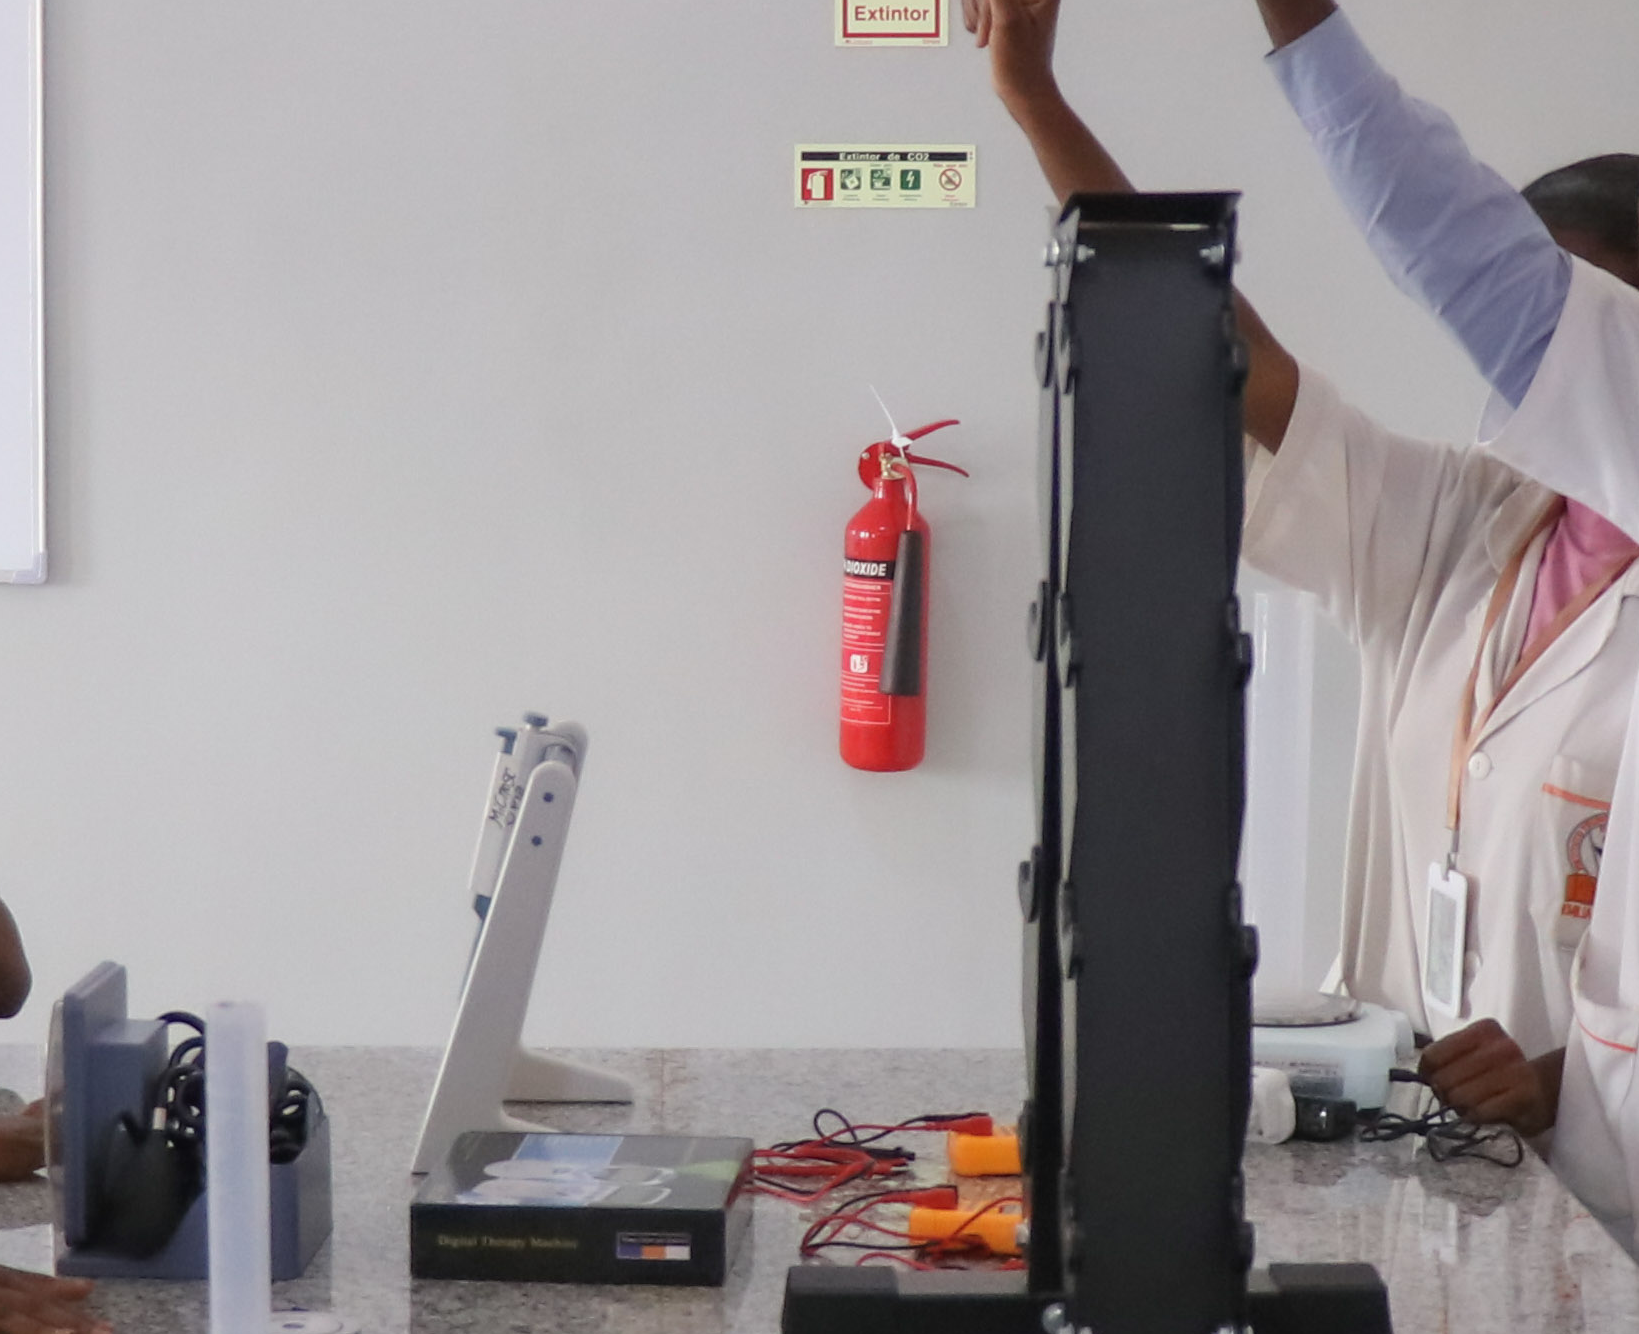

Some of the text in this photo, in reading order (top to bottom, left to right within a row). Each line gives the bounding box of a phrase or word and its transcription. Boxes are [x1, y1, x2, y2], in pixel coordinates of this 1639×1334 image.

[854, 5, 930, 22] Extintor
[839, 152, 931, 162] Extintor de CO2
